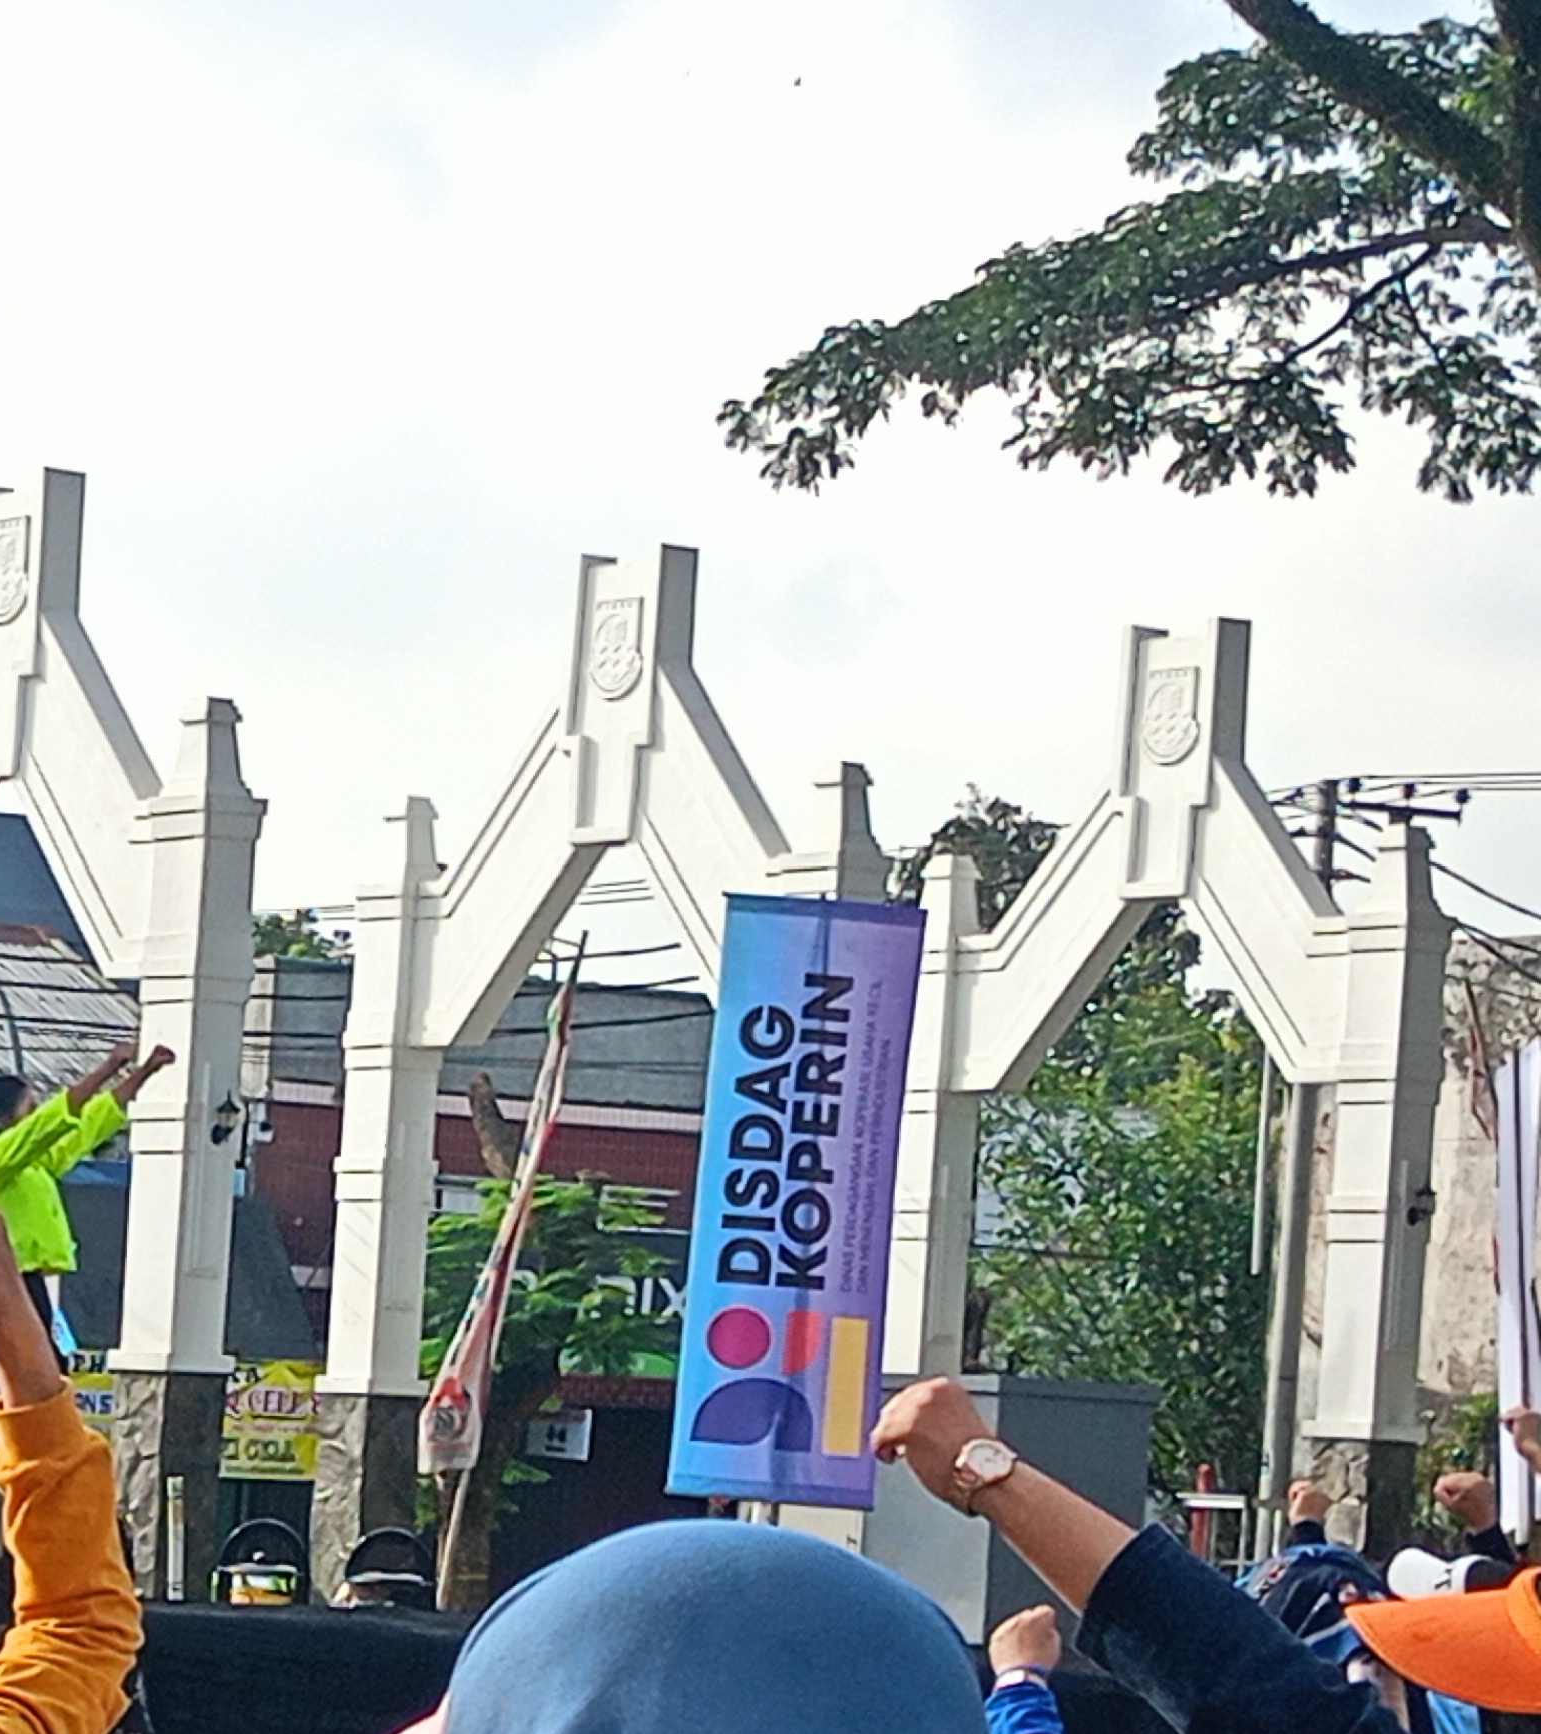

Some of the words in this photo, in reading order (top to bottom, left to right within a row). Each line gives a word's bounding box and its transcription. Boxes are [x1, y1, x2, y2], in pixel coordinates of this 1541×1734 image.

[716, 1004, 796, 1286] DISDAG
[775, 973, 855, 1291] KOPERIN
[840, 1252, 855, 1293] DINAS
